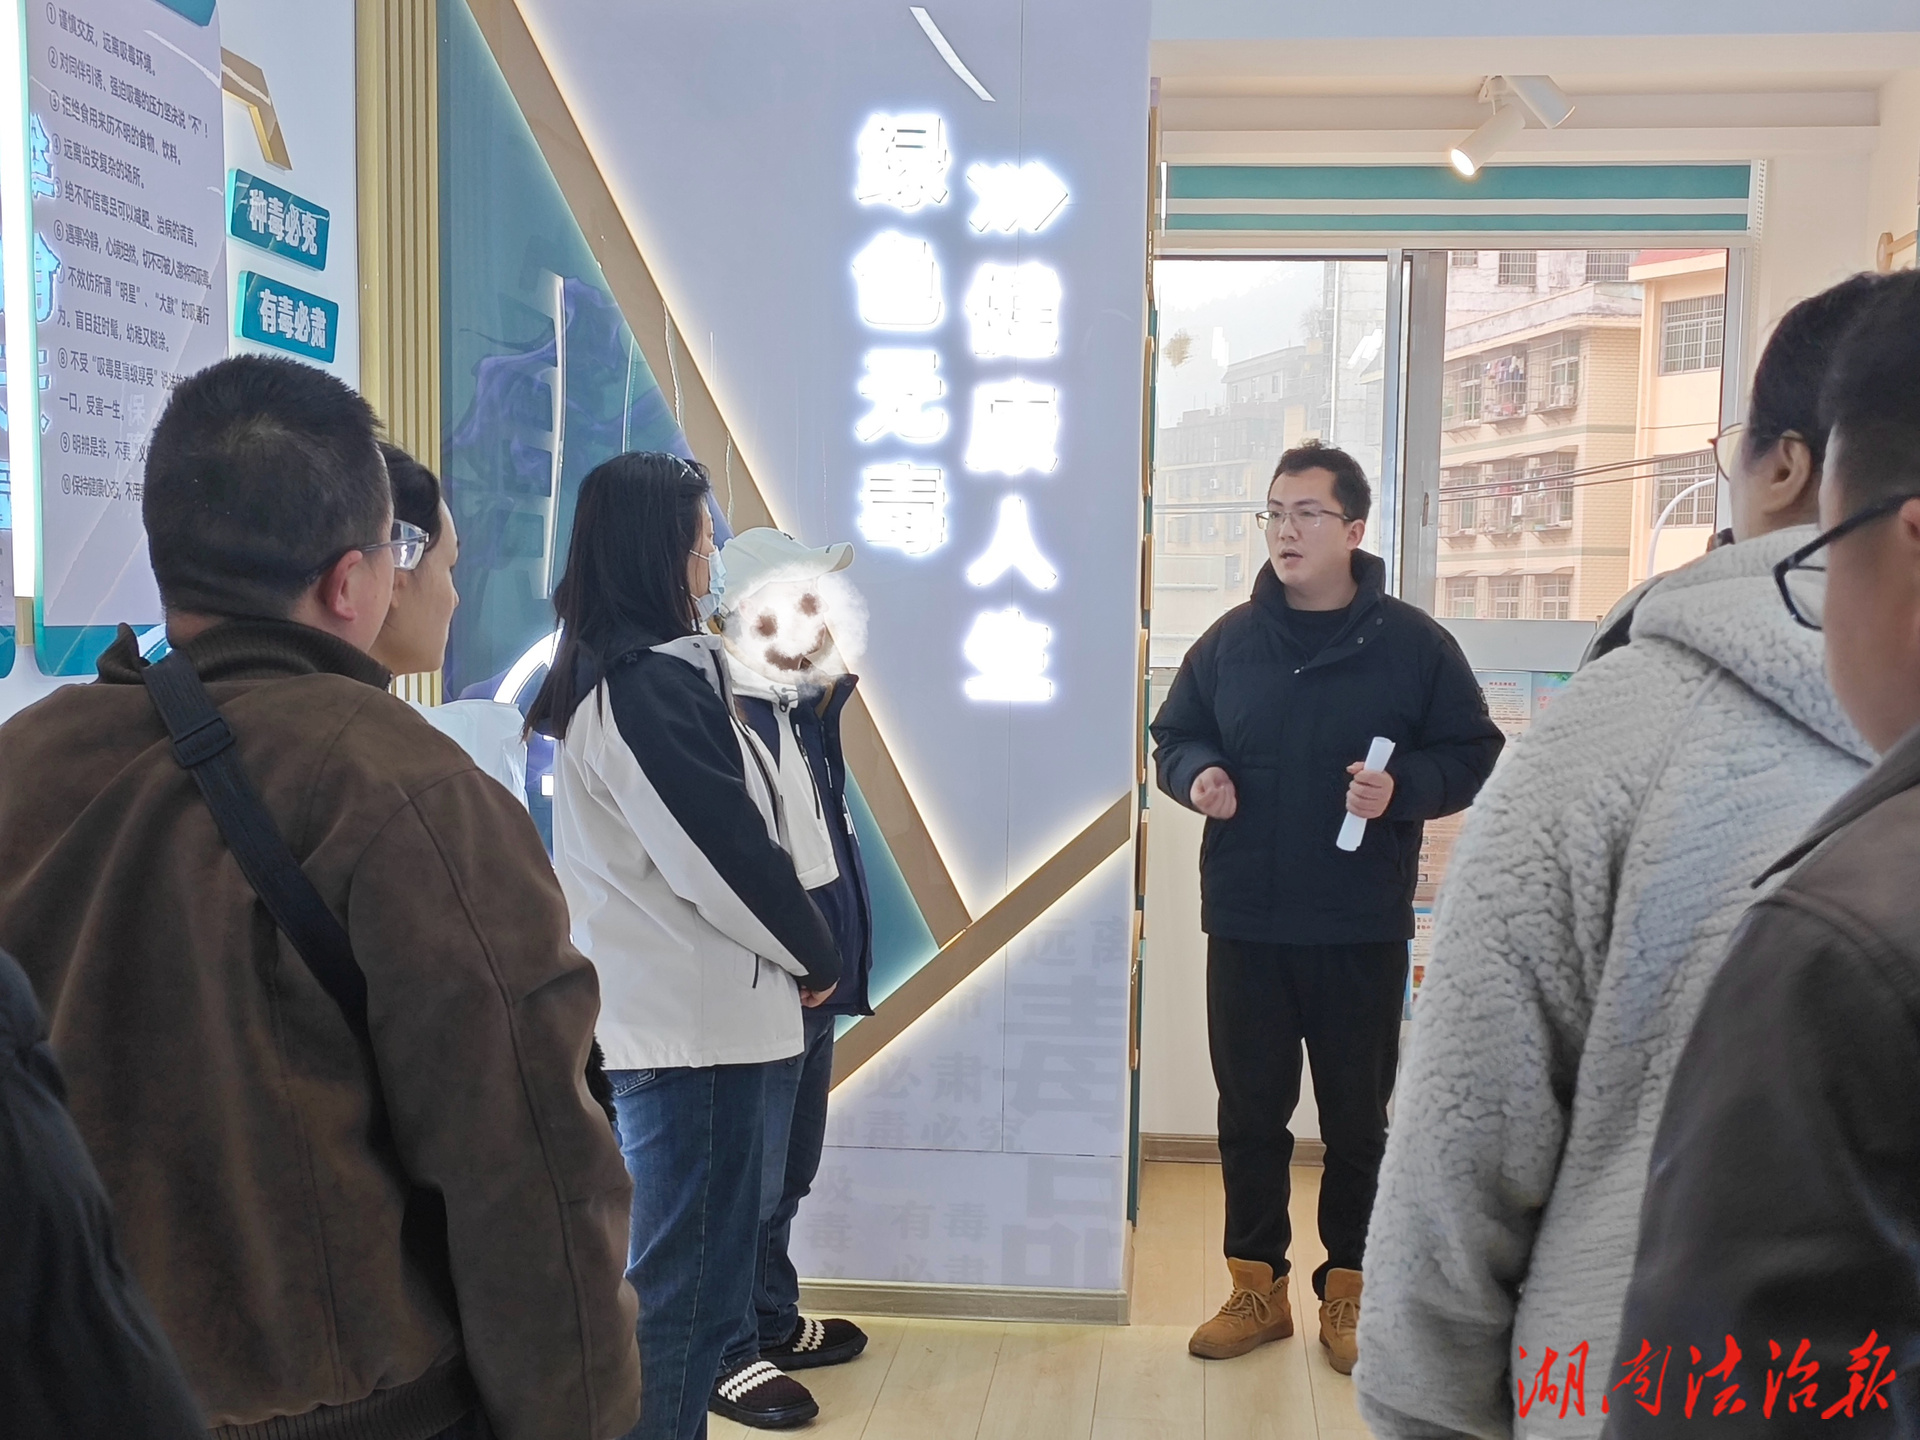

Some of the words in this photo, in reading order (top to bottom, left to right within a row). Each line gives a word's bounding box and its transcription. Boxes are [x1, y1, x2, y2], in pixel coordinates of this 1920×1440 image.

[248, 189, 318, 255] 种毒必究
[259, 289, 327, 348] 有毒必肃
